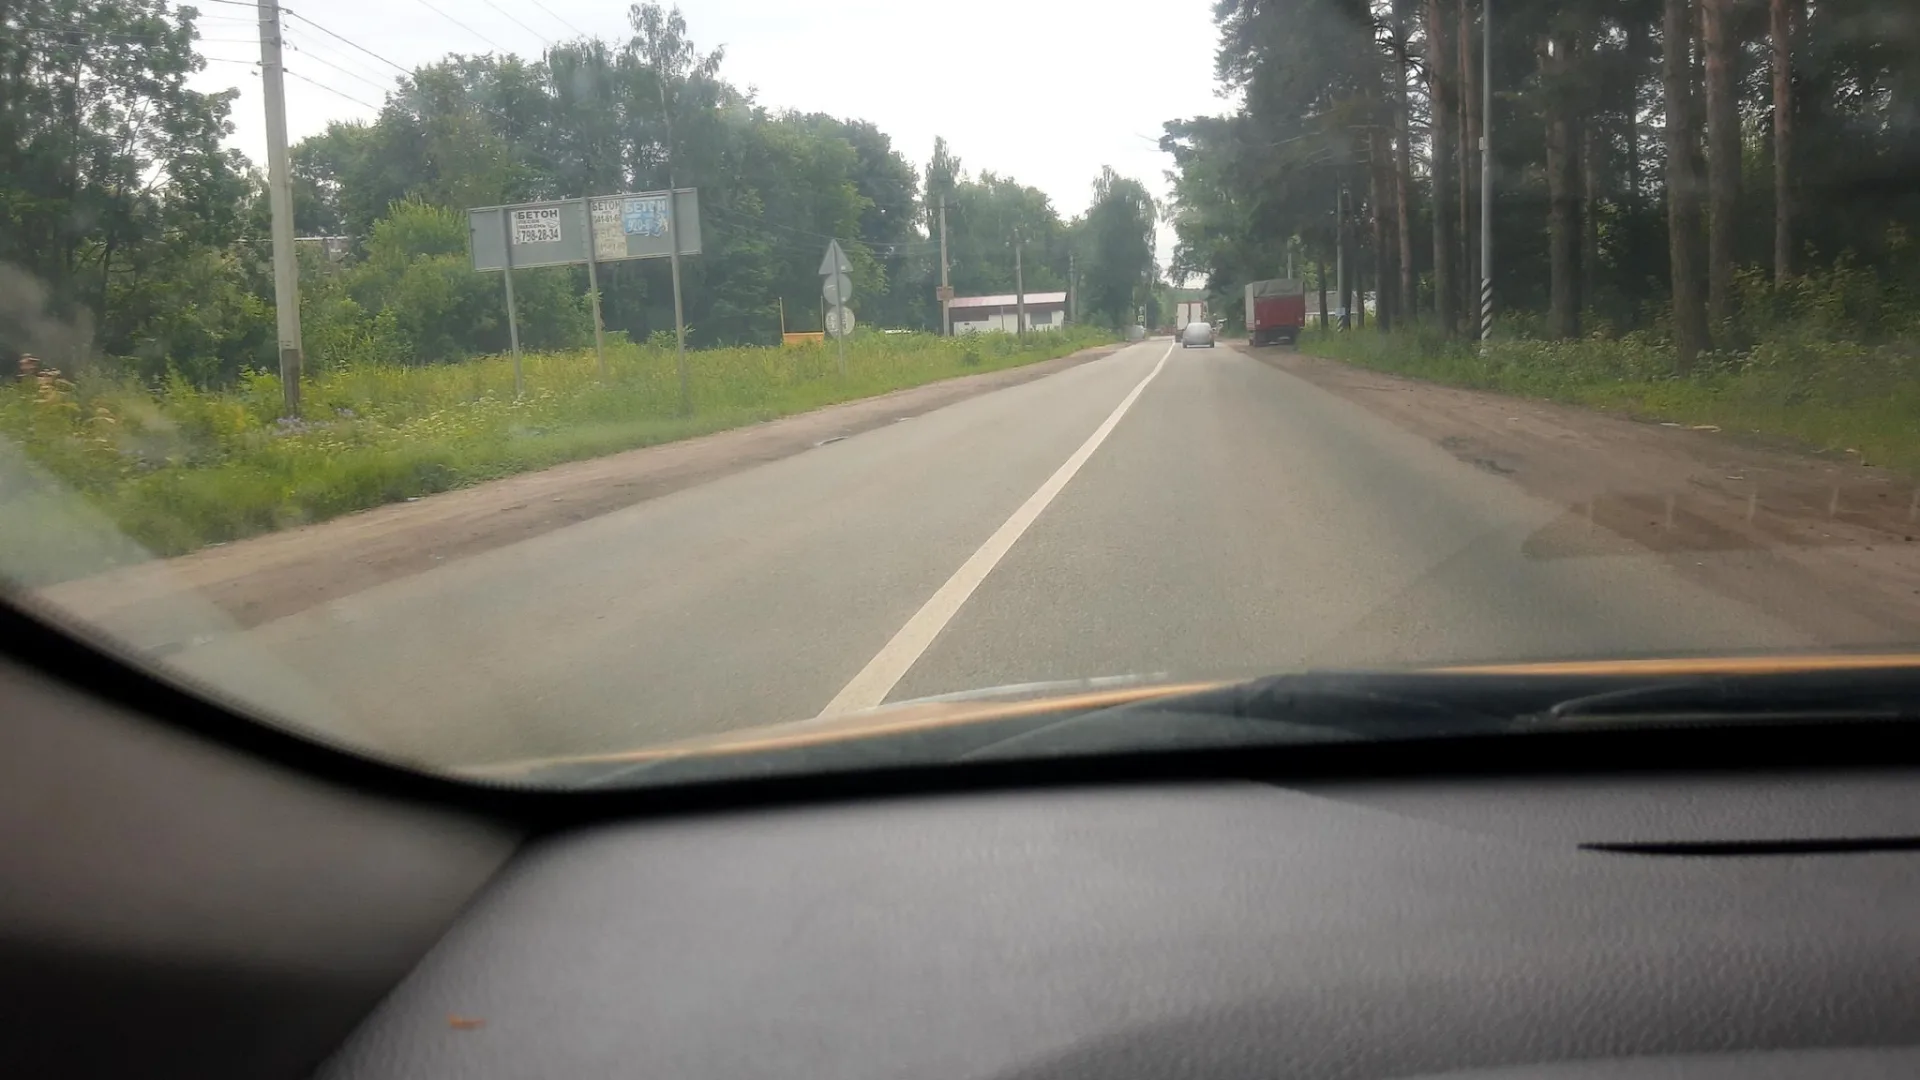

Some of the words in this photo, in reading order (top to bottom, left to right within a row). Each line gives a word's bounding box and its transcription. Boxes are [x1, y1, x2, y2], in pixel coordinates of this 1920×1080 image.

[592, 201, 620, 211] БЕТОН
[625, 200, 666, 213] БЕТОН
[518, 210, 558, 219] БЕТОН
[521, 229, 559, 241] 798-28-34
